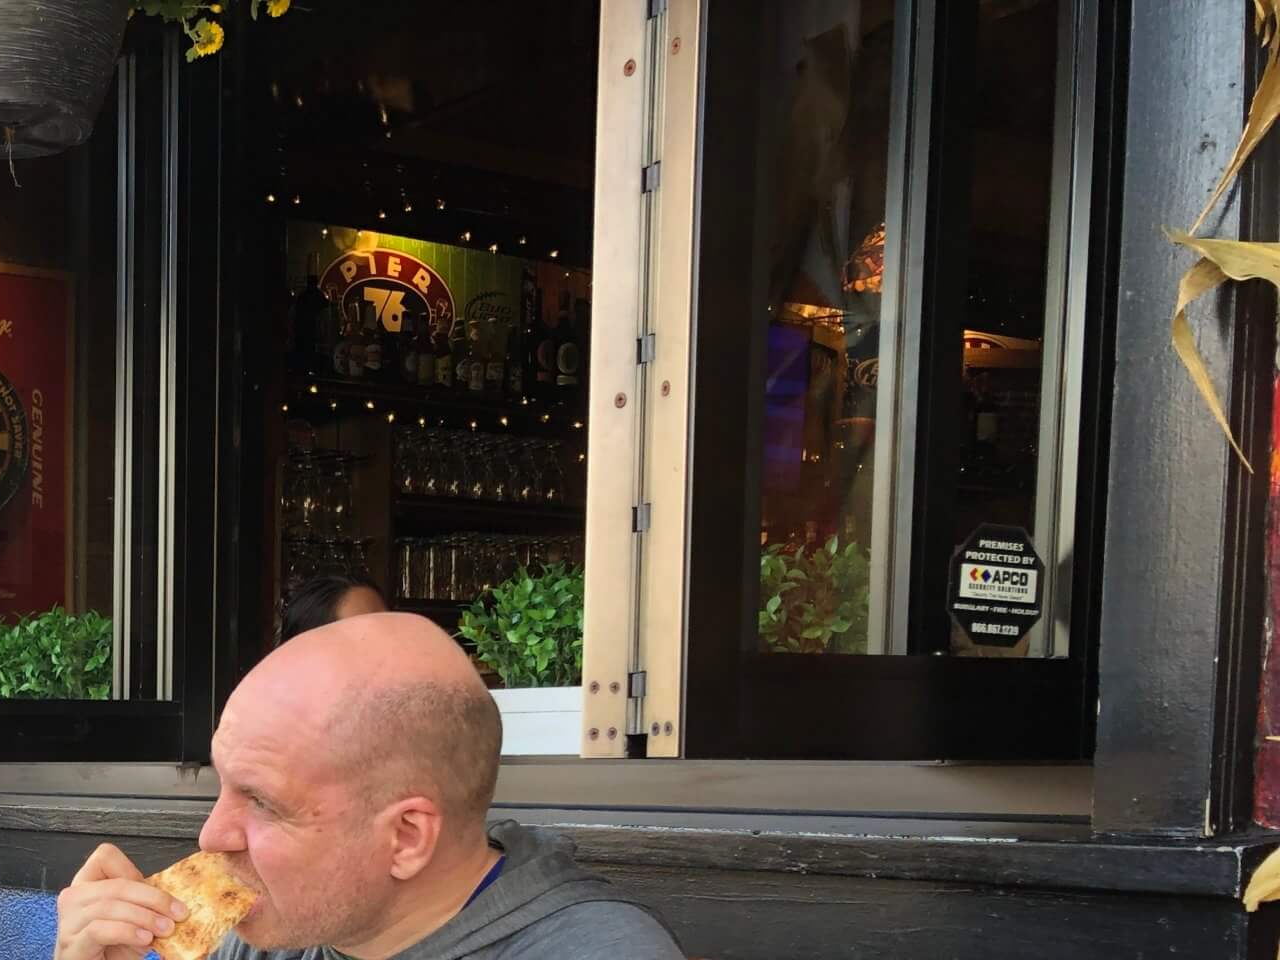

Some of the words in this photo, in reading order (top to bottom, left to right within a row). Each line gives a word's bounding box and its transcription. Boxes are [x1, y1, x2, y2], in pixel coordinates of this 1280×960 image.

[340, 252, 431, 294] PIER
[364, 287, 407, 333] 76
[32, 389, 43, 508] GENUINE
[966, 551, 1021, 563] PROTECTED
[1022, 556, 1035, 565] BY
[979, 540, 1024, 551] PREMISES
[992, 570, 1028, 586] APCO
